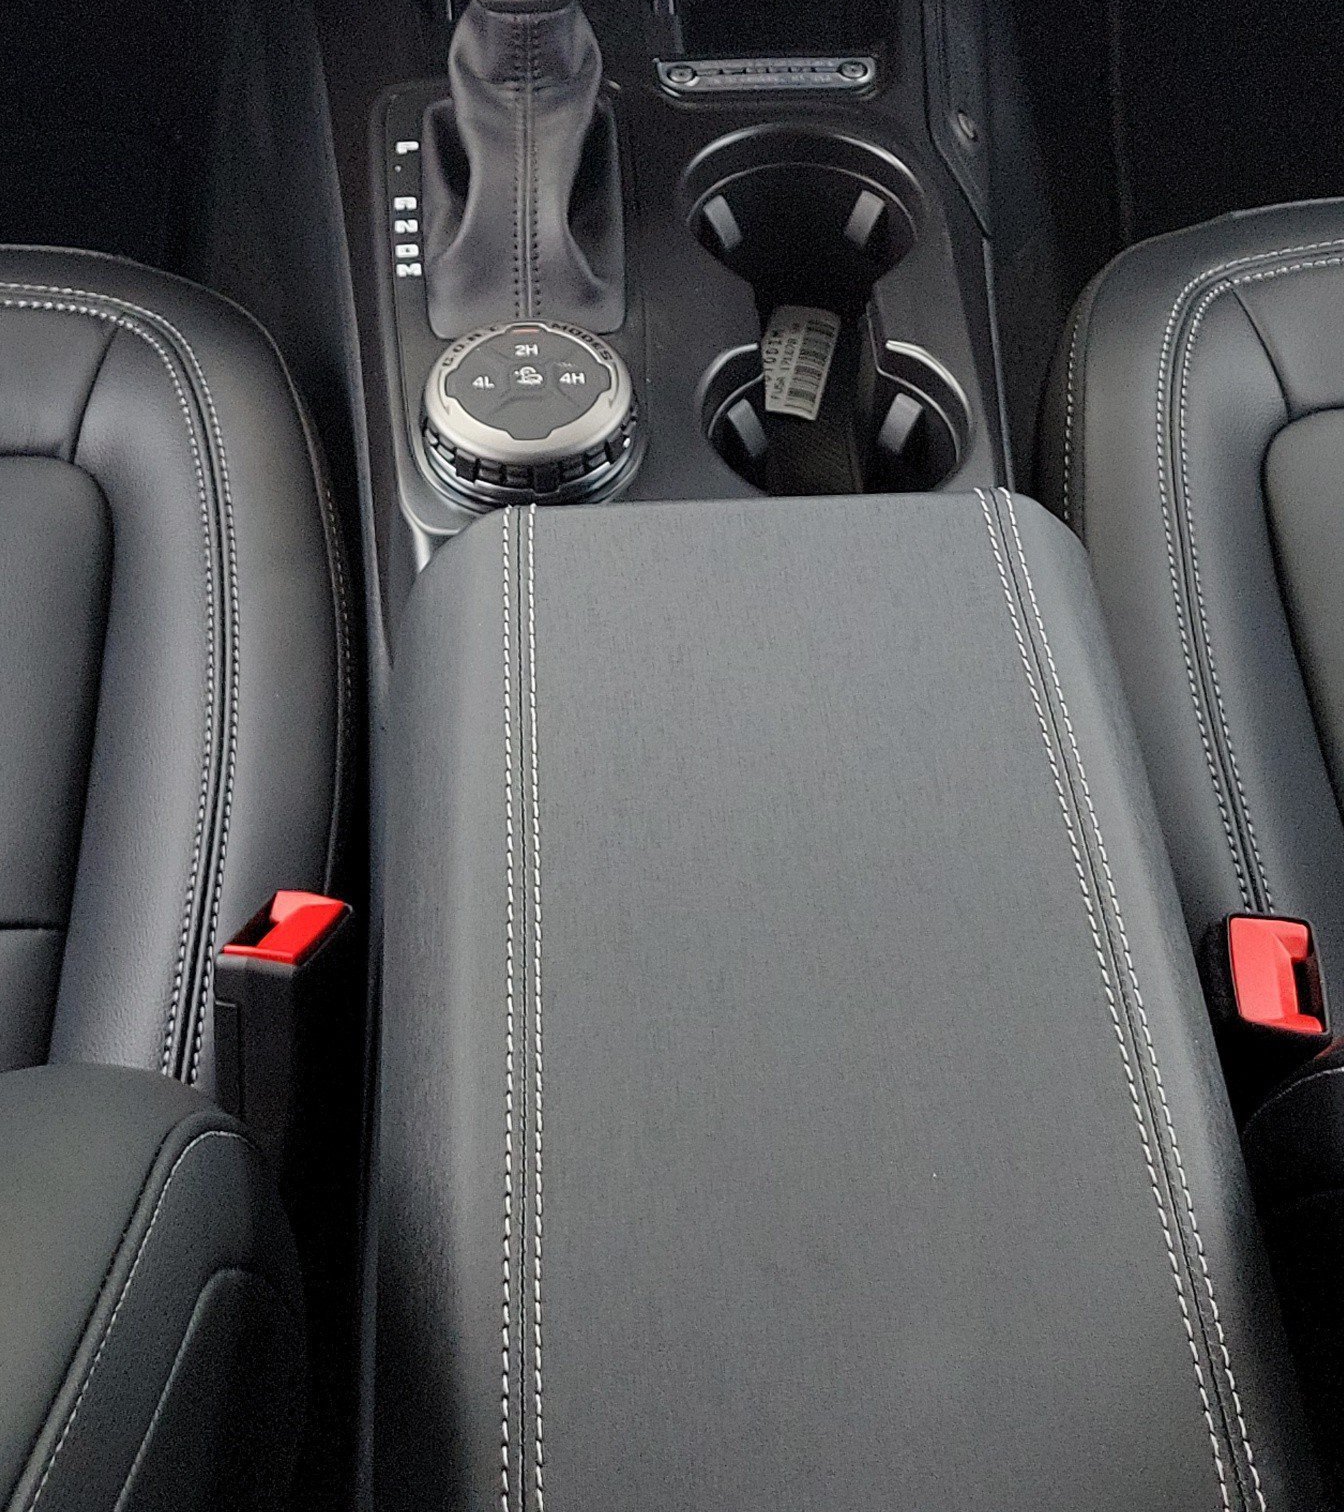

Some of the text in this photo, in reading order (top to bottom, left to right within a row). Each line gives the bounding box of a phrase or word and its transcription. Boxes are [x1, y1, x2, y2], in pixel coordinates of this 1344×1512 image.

[395, 219, 418, 234] N
[396, 262, 422, 277] M
[514, 344, 539, 357] 2H
[472, 376, 495, 389] 4L
[559, 372, 586, 385] 4H
